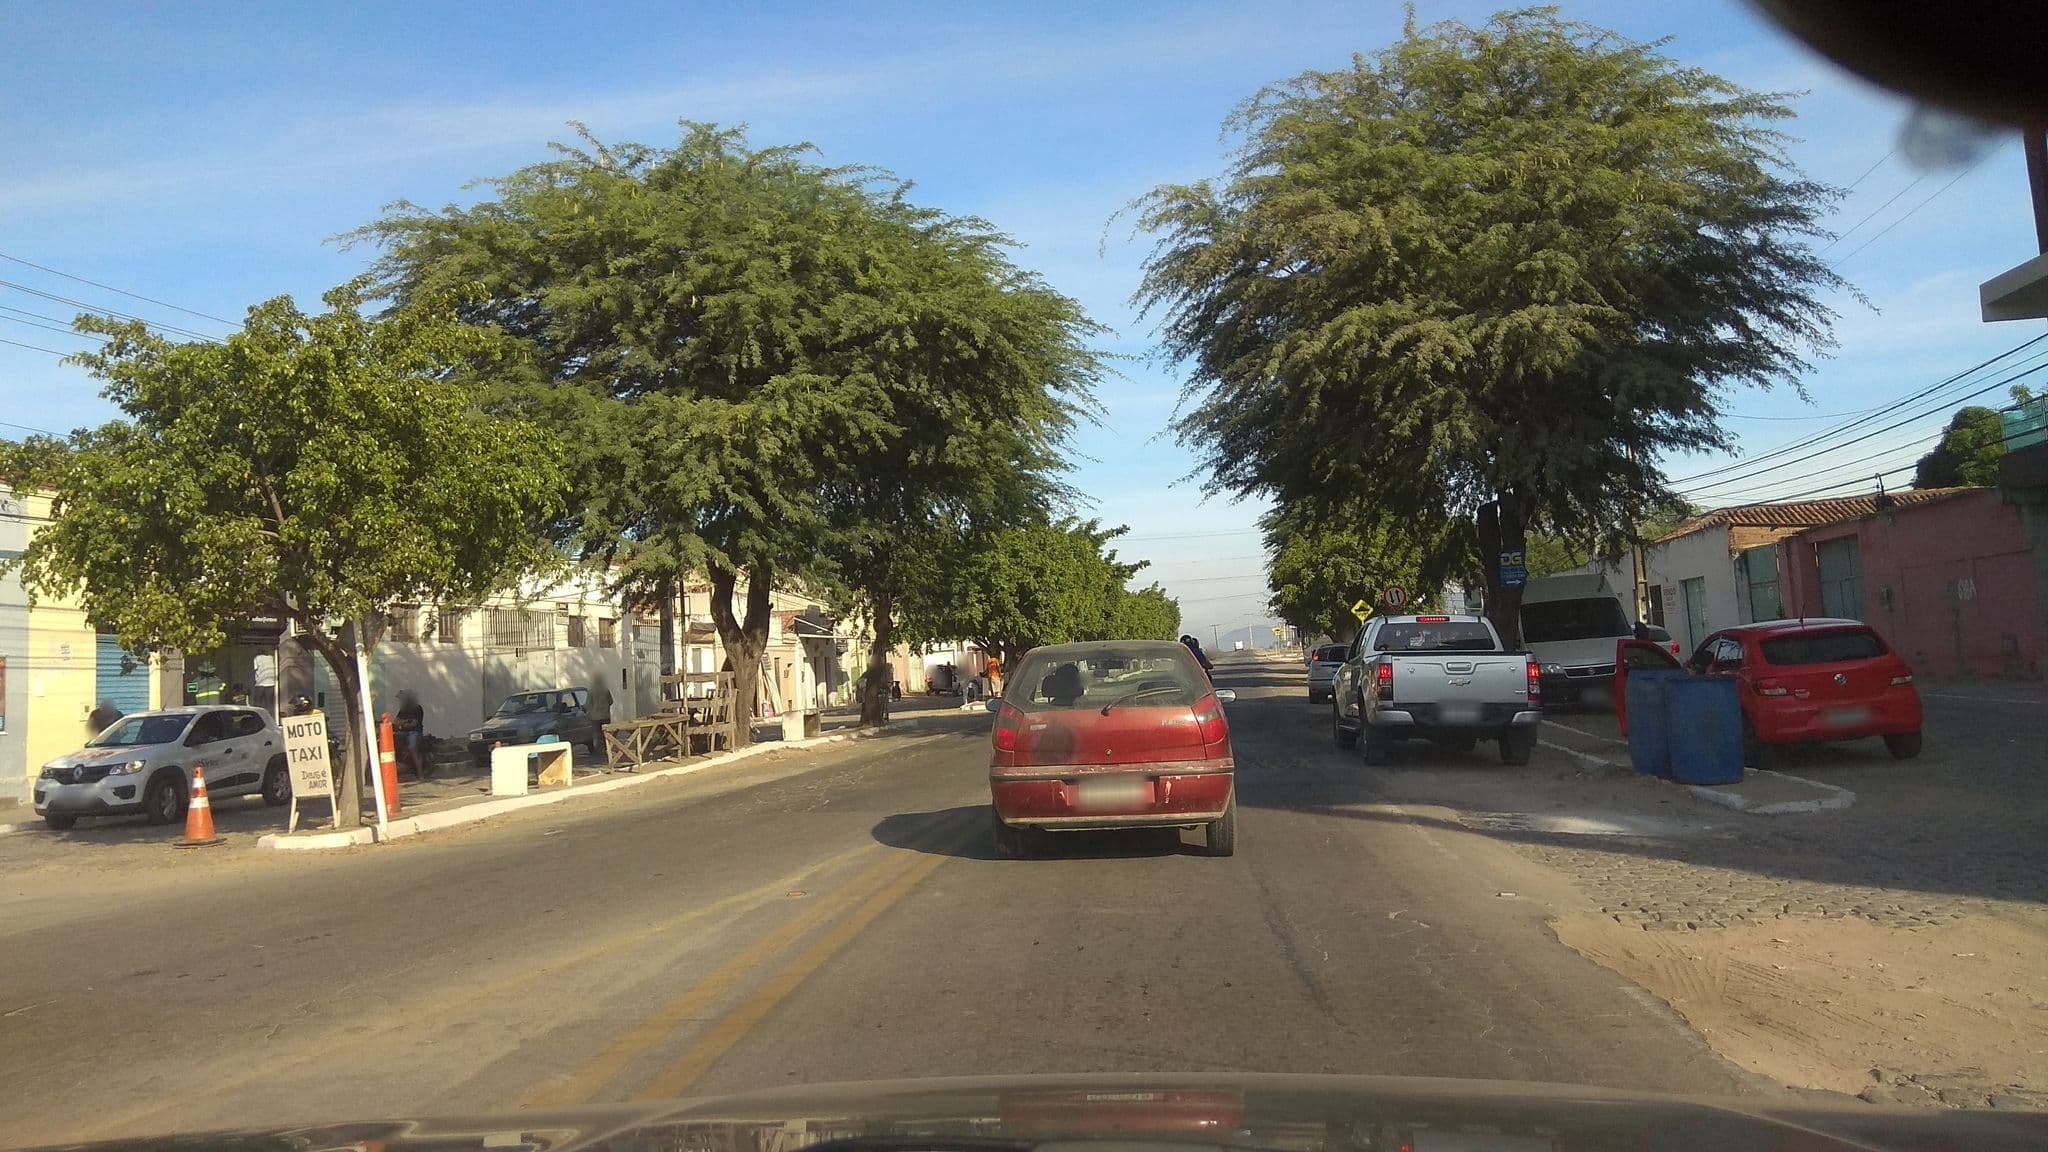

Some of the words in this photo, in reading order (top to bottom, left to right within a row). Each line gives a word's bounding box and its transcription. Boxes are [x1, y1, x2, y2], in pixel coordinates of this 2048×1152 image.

[287, 721, 322, 739] MOTO
[289, 746, 323, 763] TAXI
[309, 780, 328, 789] AMOR
